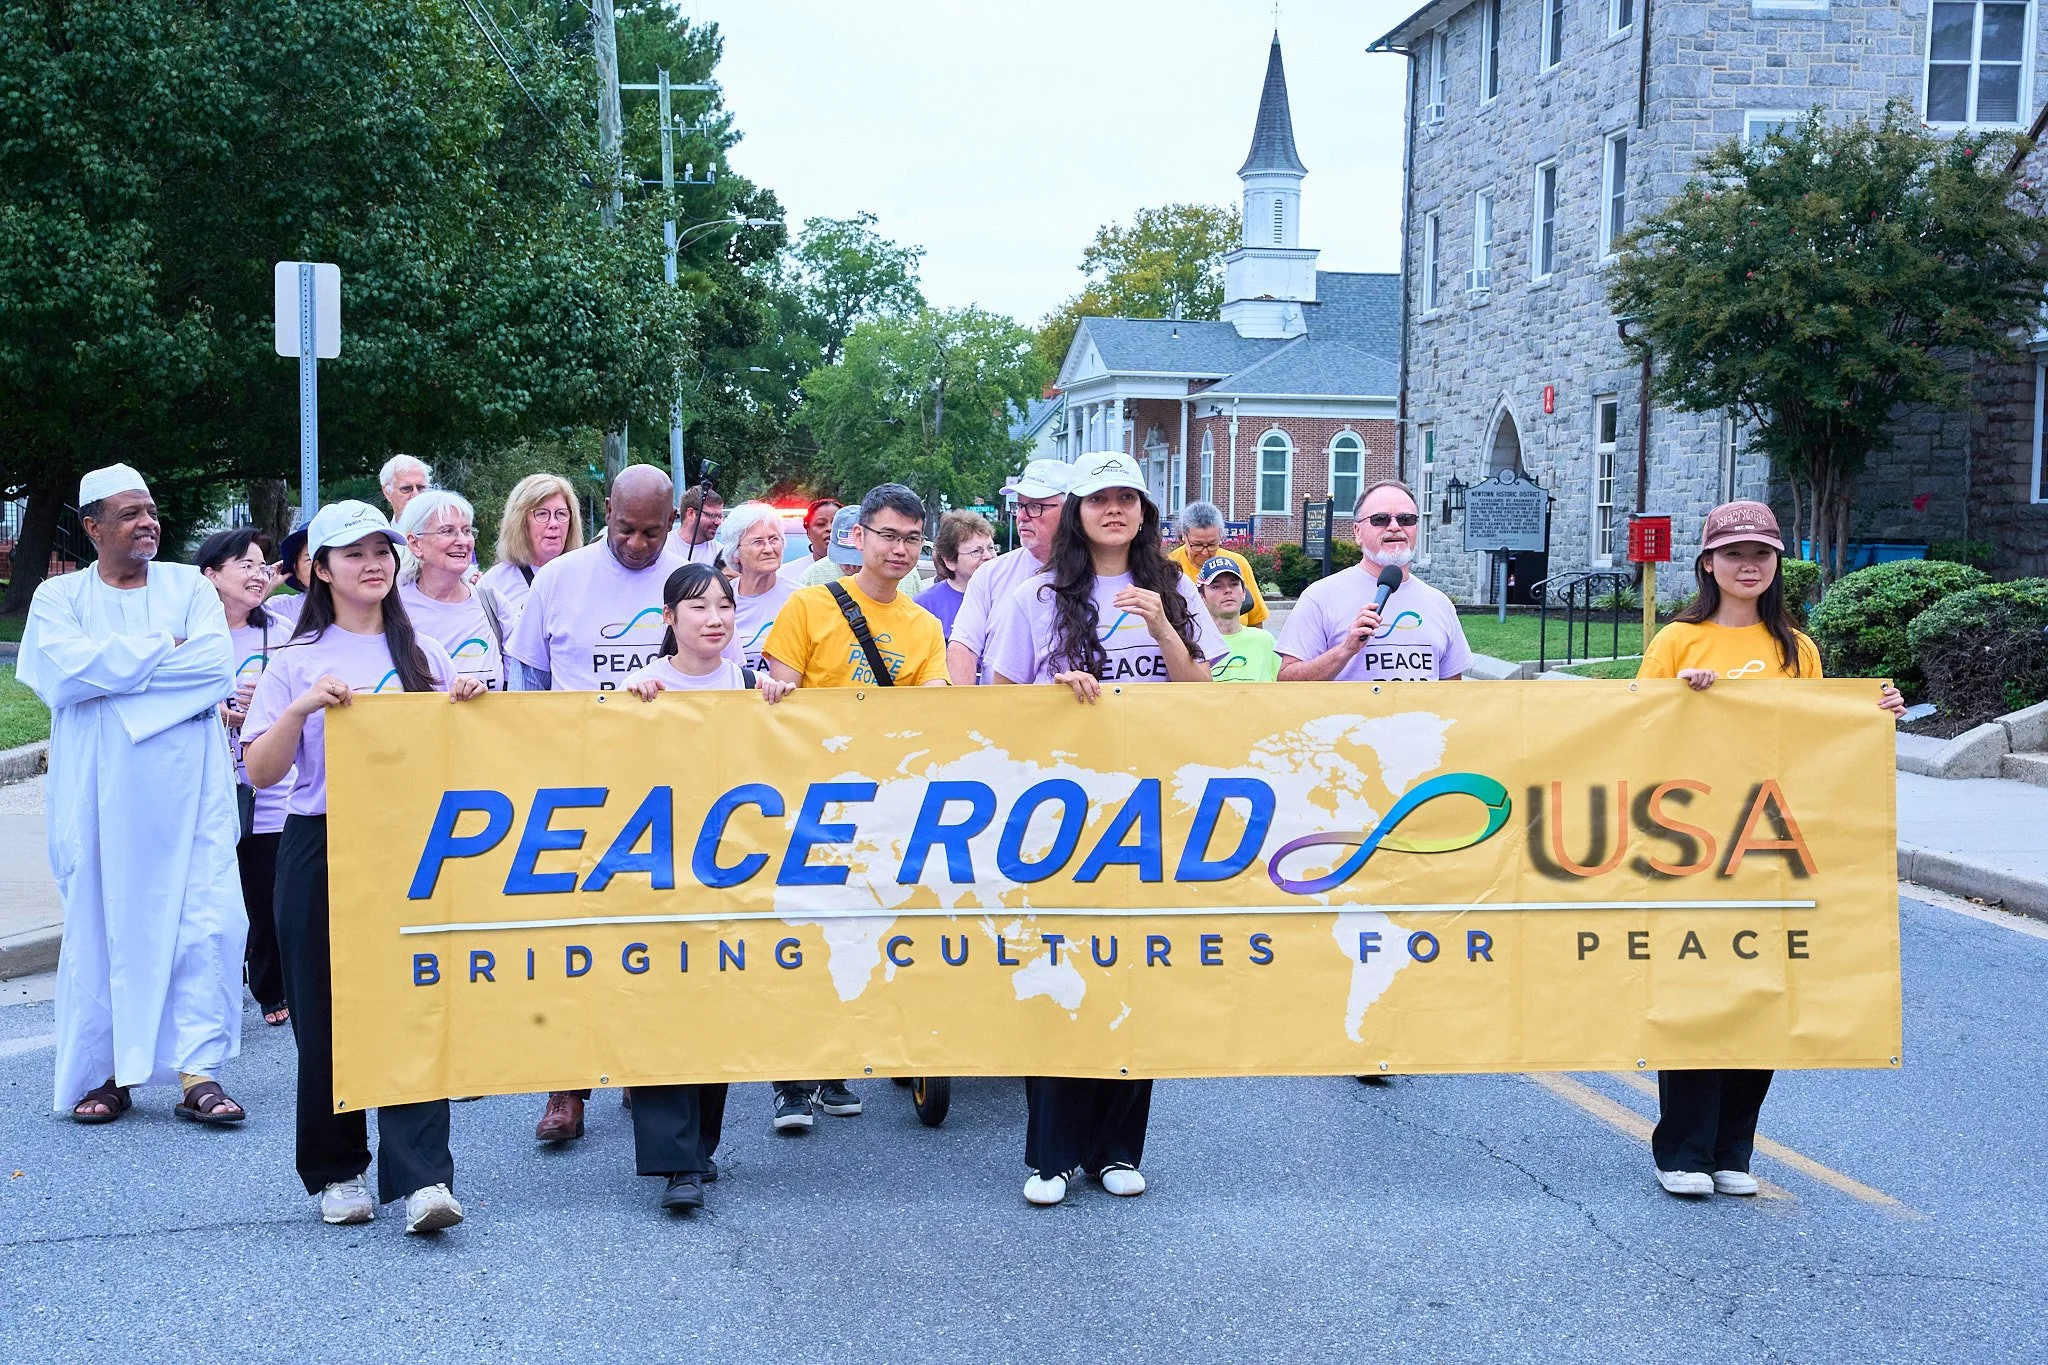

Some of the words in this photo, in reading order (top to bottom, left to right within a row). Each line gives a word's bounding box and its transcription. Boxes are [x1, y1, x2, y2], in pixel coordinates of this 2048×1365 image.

[1716, 510, 1740, 529] NEW
[1740, 509, 1769, 526] YORK
[1209, 558, 1234, 569] USA
[593, 653, 660, 673] PEA
[1100, 656, 1167, 680] EACE
[1365, 652, 1432, 670] PEACE
[407, 782, 877, 900] PEACE
[896, 777, 1276, 885] ROAD
[1528, 779, 1819, 880] USA
[413, 937, 803, 986] BRIDGING
[887, 934, 1274, 967] CULTURES
[1358, 930, 1494, 963] FOR
[1577, 929, 1810, 961] PEACE
